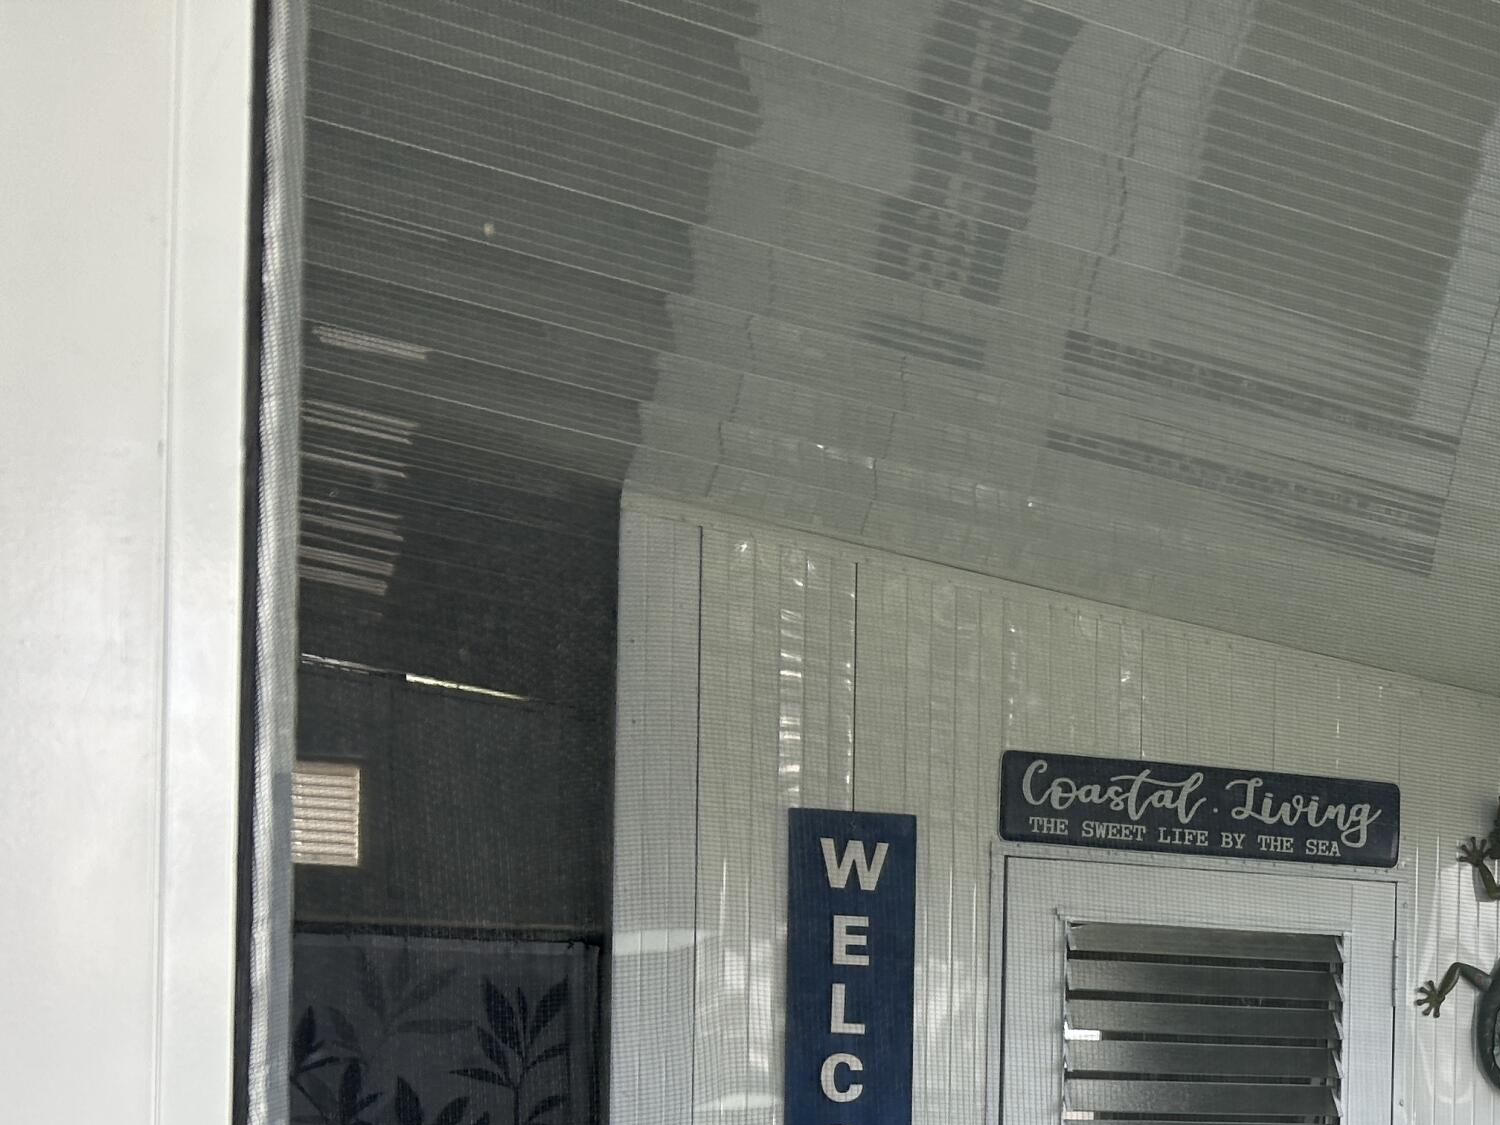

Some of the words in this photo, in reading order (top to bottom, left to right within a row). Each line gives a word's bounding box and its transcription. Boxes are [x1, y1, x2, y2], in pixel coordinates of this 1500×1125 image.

[1022, 759, 1207, 824] Coastal
[1225, 777, 1382, 848] Living
[1029, 816, 1069, 836] THE
[1081, 820, 1146, 841] SWEET
[1158, 827, 1209, 847] LIFE
[1220, 831, 1246, 849] BY
[1257, 835, 1294, 853] THE
[1305, 839, 1342, 857] SEA
